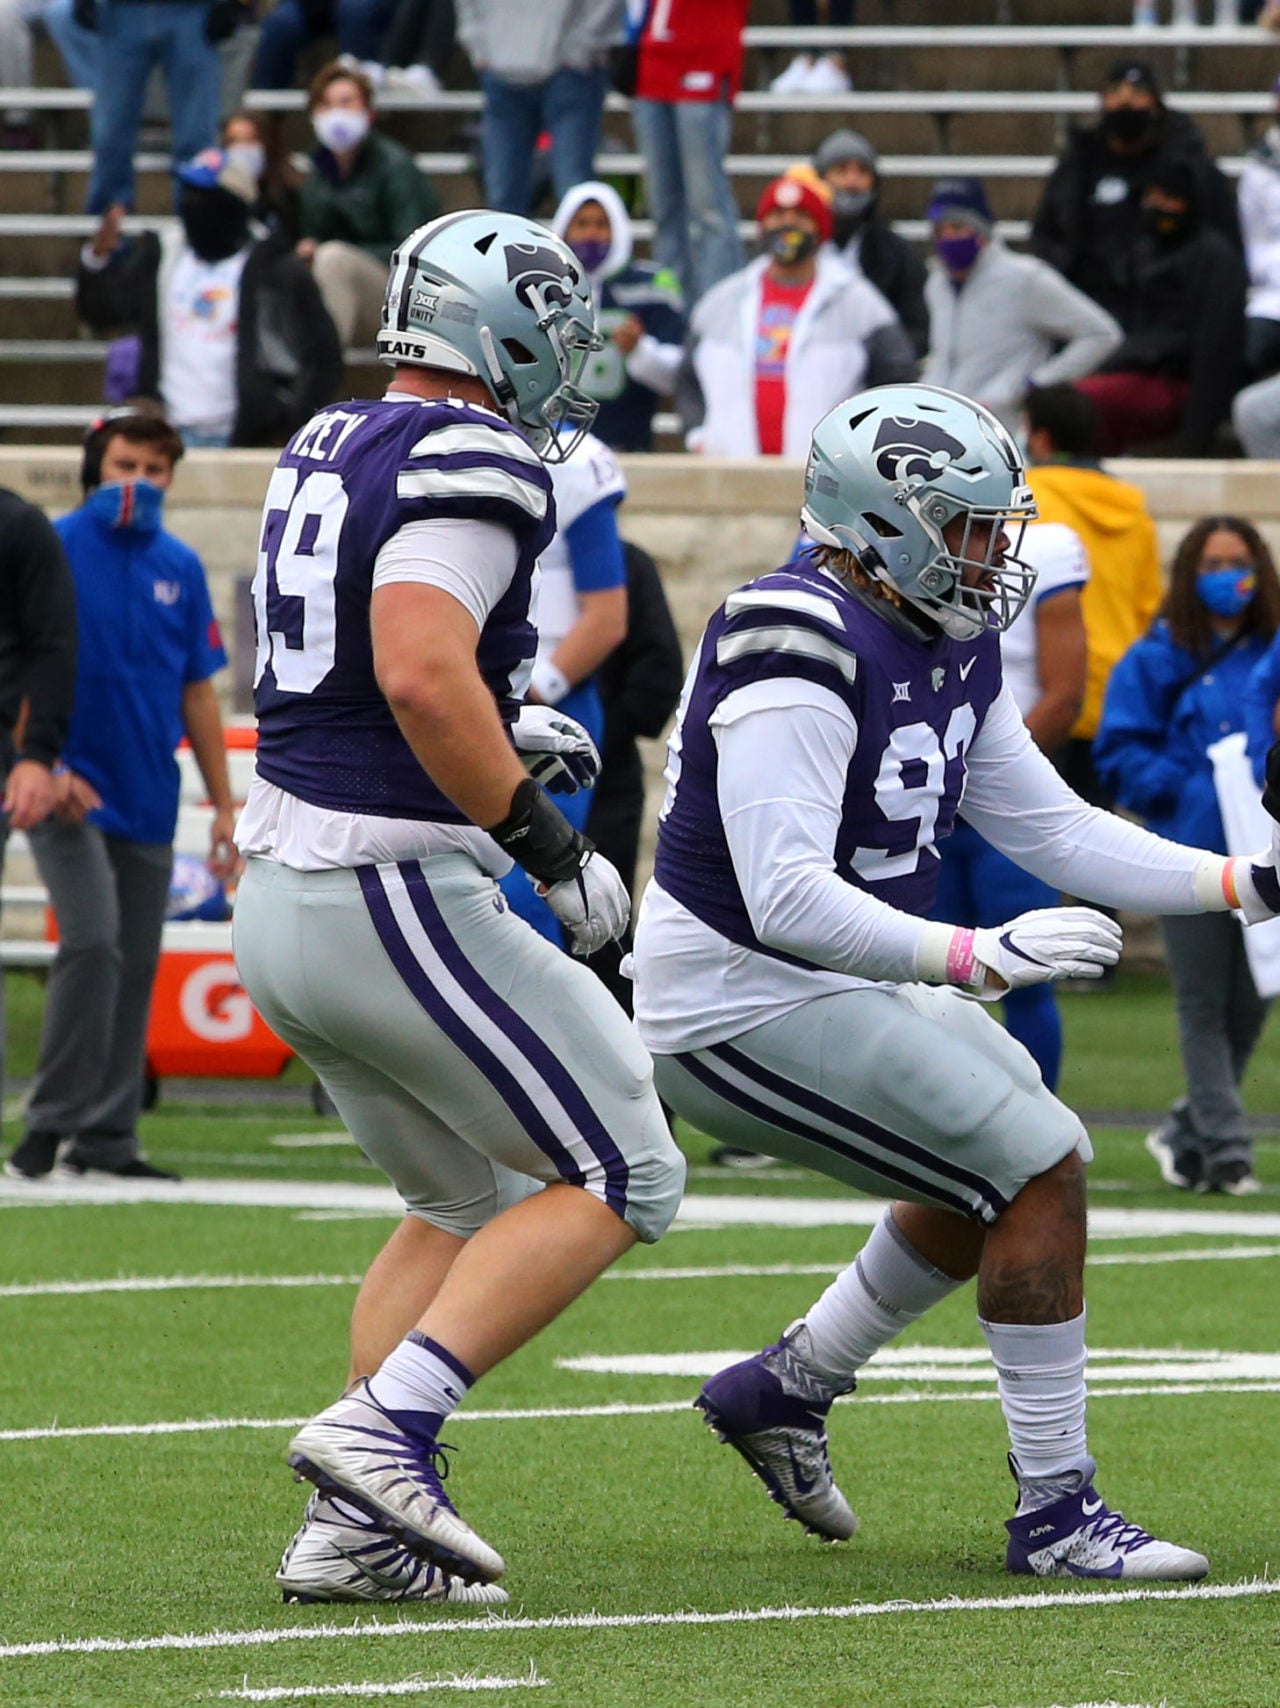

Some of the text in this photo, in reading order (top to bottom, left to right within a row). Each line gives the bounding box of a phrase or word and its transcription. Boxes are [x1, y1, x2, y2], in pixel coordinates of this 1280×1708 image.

[410, 308, 435, 325] UNITY
[179, 960, 255, 1043] G
[1028, 1523, 1056, 1539] ALPHA
